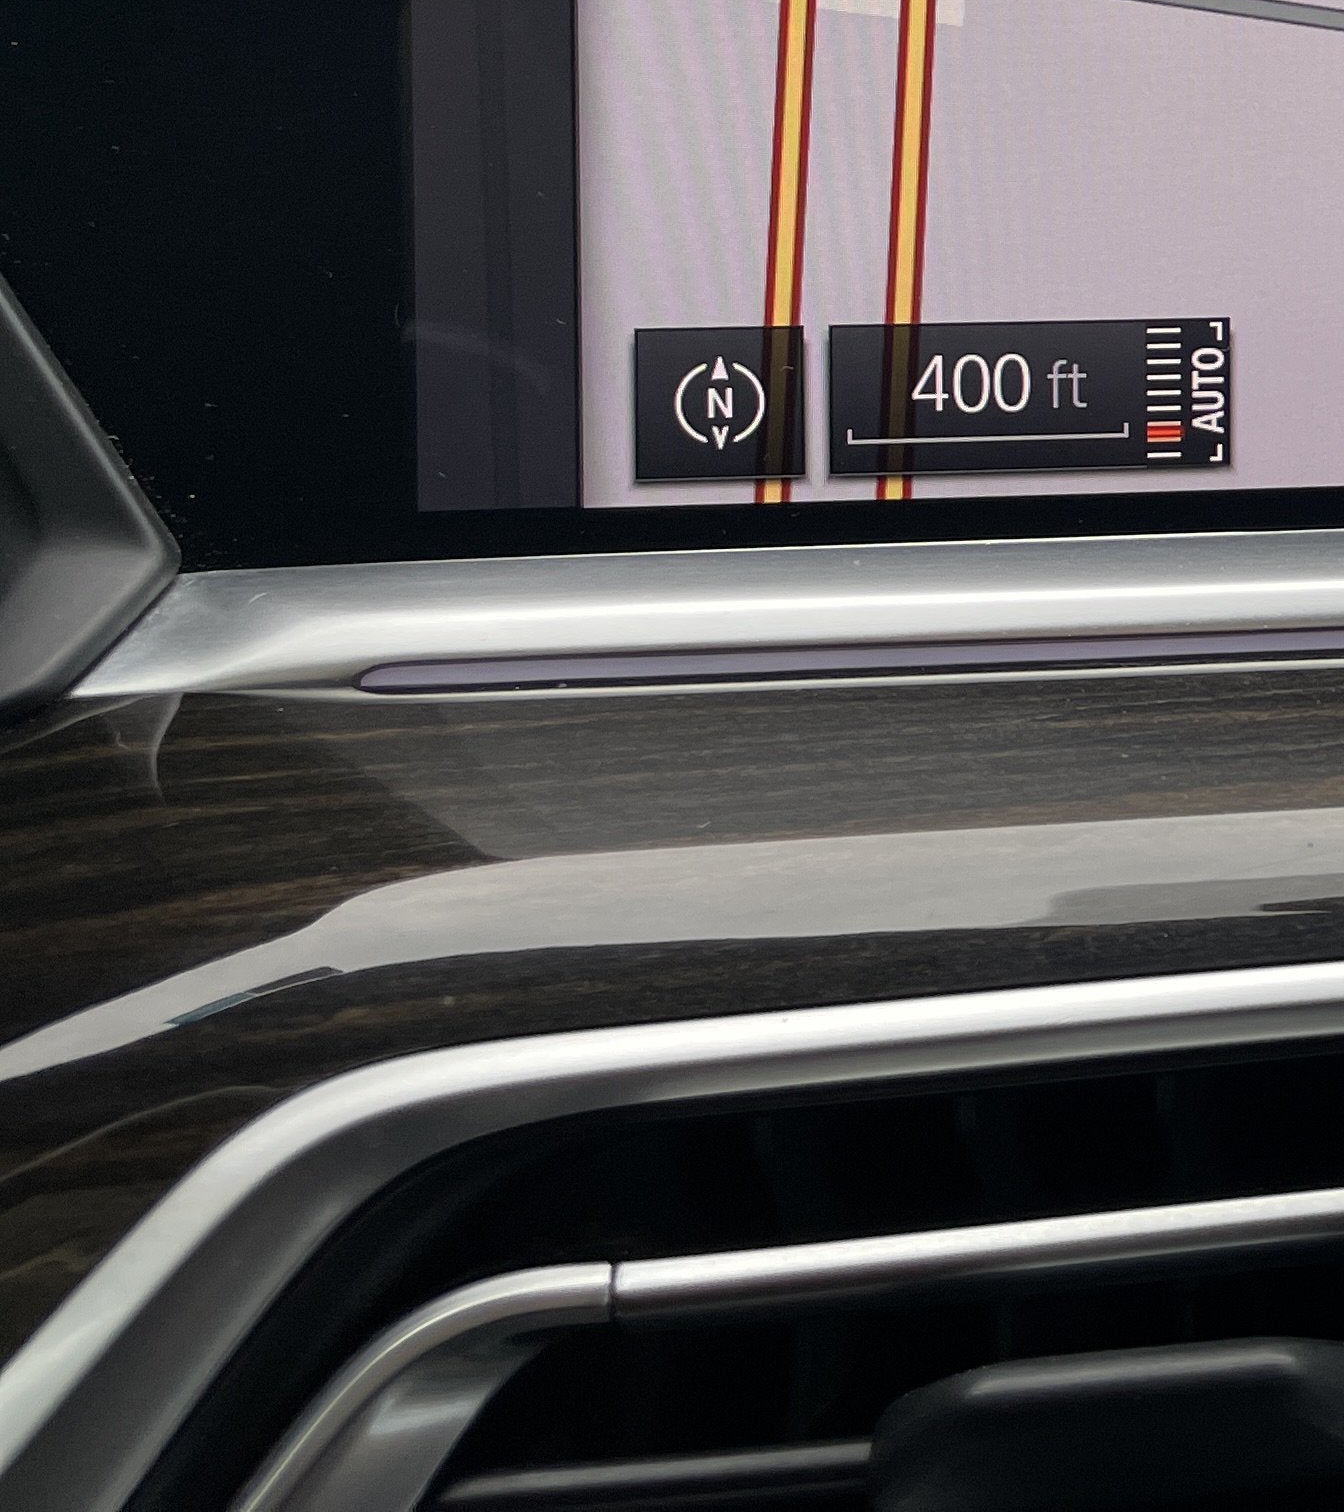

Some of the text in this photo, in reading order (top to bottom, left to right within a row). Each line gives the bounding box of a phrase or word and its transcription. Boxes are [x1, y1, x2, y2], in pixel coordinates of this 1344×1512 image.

[910, 352, 1088, 414] 400 ft
[1191, 347, 1226, 434] AUTO
